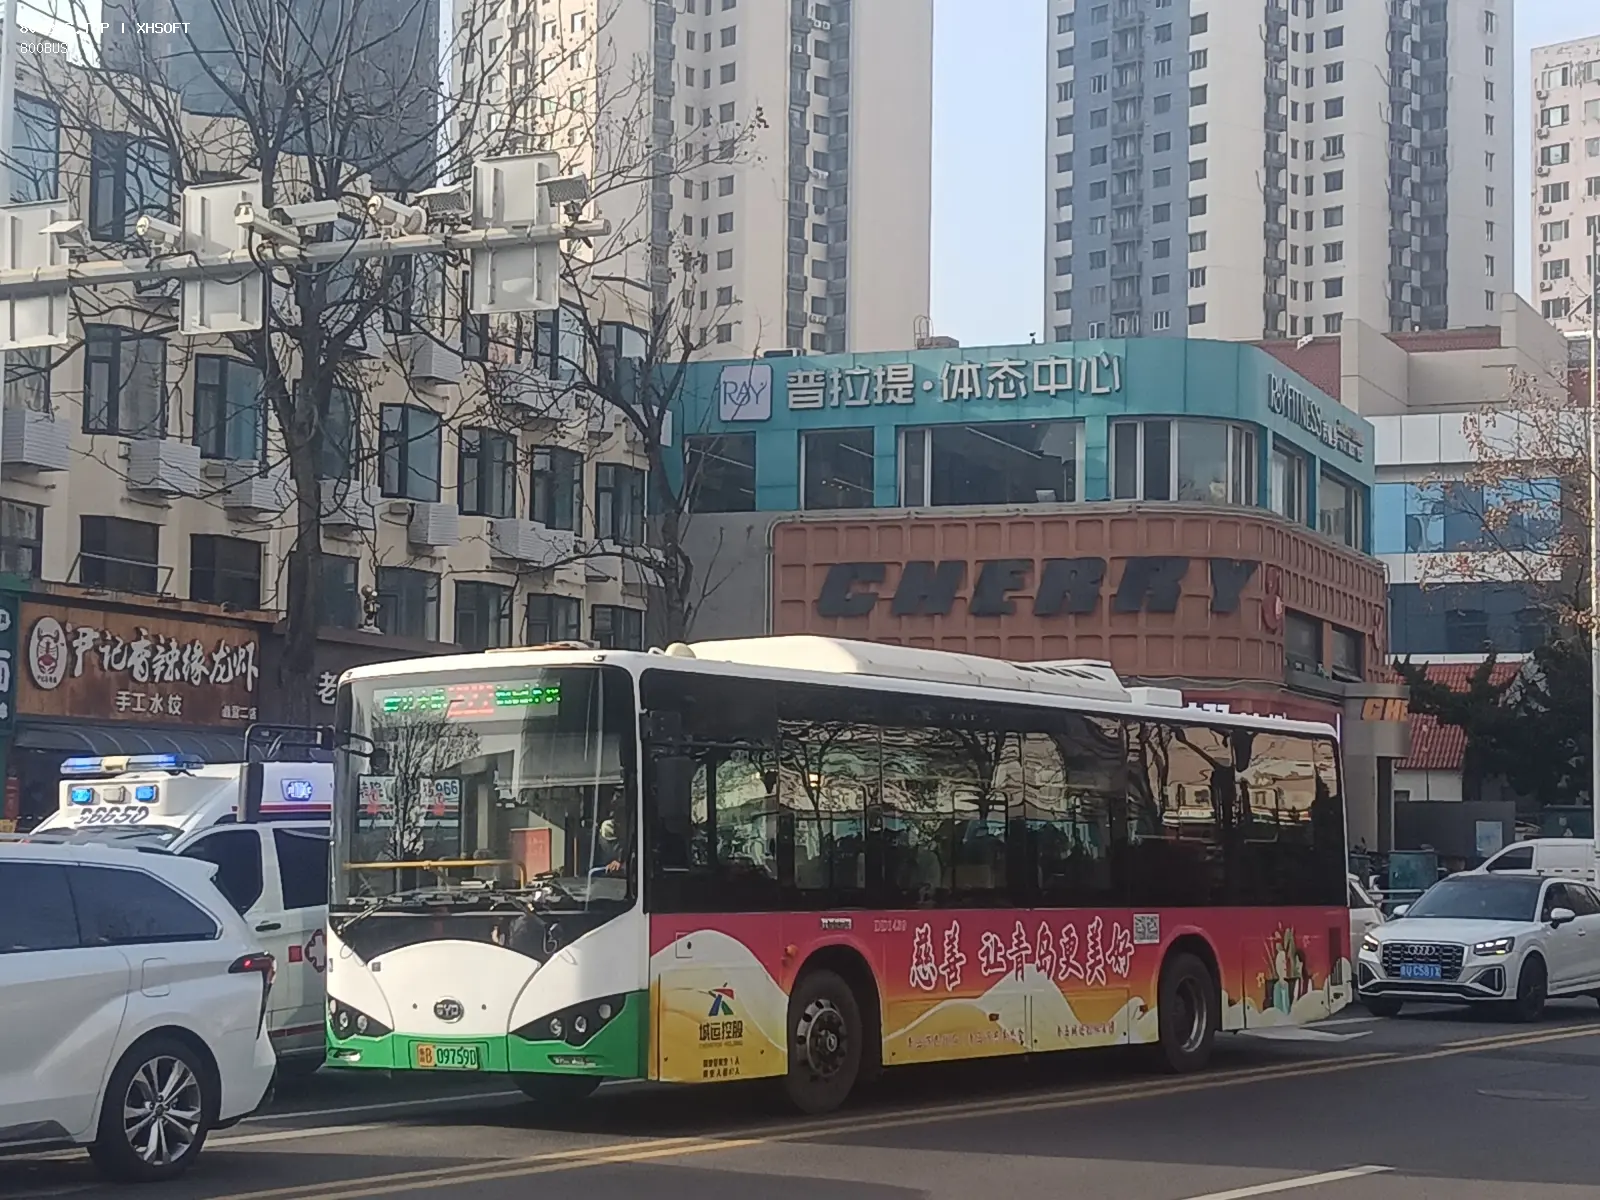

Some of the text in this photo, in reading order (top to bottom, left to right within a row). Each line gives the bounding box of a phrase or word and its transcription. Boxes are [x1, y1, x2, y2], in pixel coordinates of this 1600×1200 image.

[722, 379, 767, 406] RAY
[816, 556, 1260, 617] CHERRY
[115, 690, 182, 716] 手工水饺
[910, 915, 1135, 991] 慈善 让青岛更美好
[436, 1003, 459, 1017] BYD
[698, 1020, 744, 1041] 城运控股
